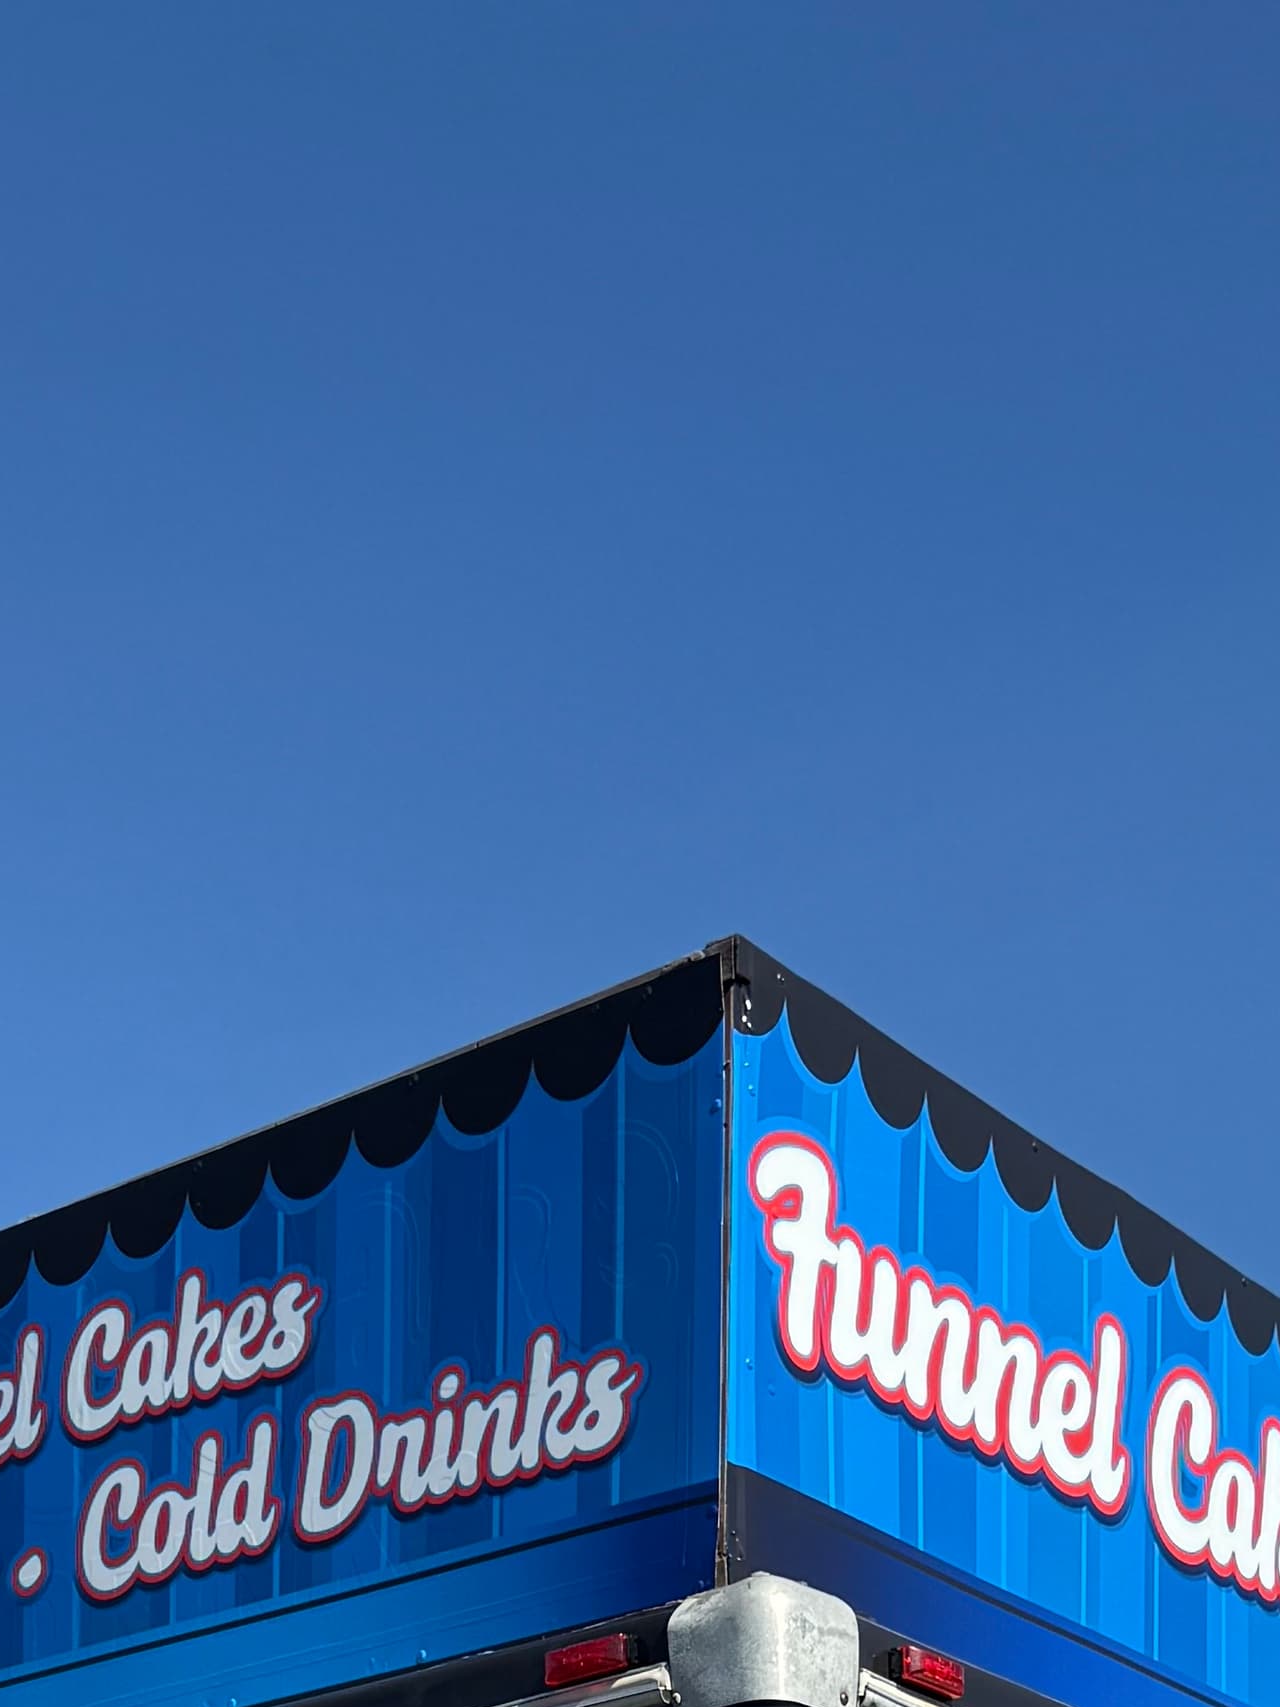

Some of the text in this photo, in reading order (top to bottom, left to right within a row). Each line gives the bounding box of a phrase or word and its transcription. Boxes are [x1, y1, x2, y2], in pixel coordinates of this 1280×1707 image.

[64, 1270, 320, 1436] Cakes
[750, 1132, 1127, 1517] Funnel
[80, 1414, 282, 1598] Cold
[296, 1326, 642, 1542] Drinks
